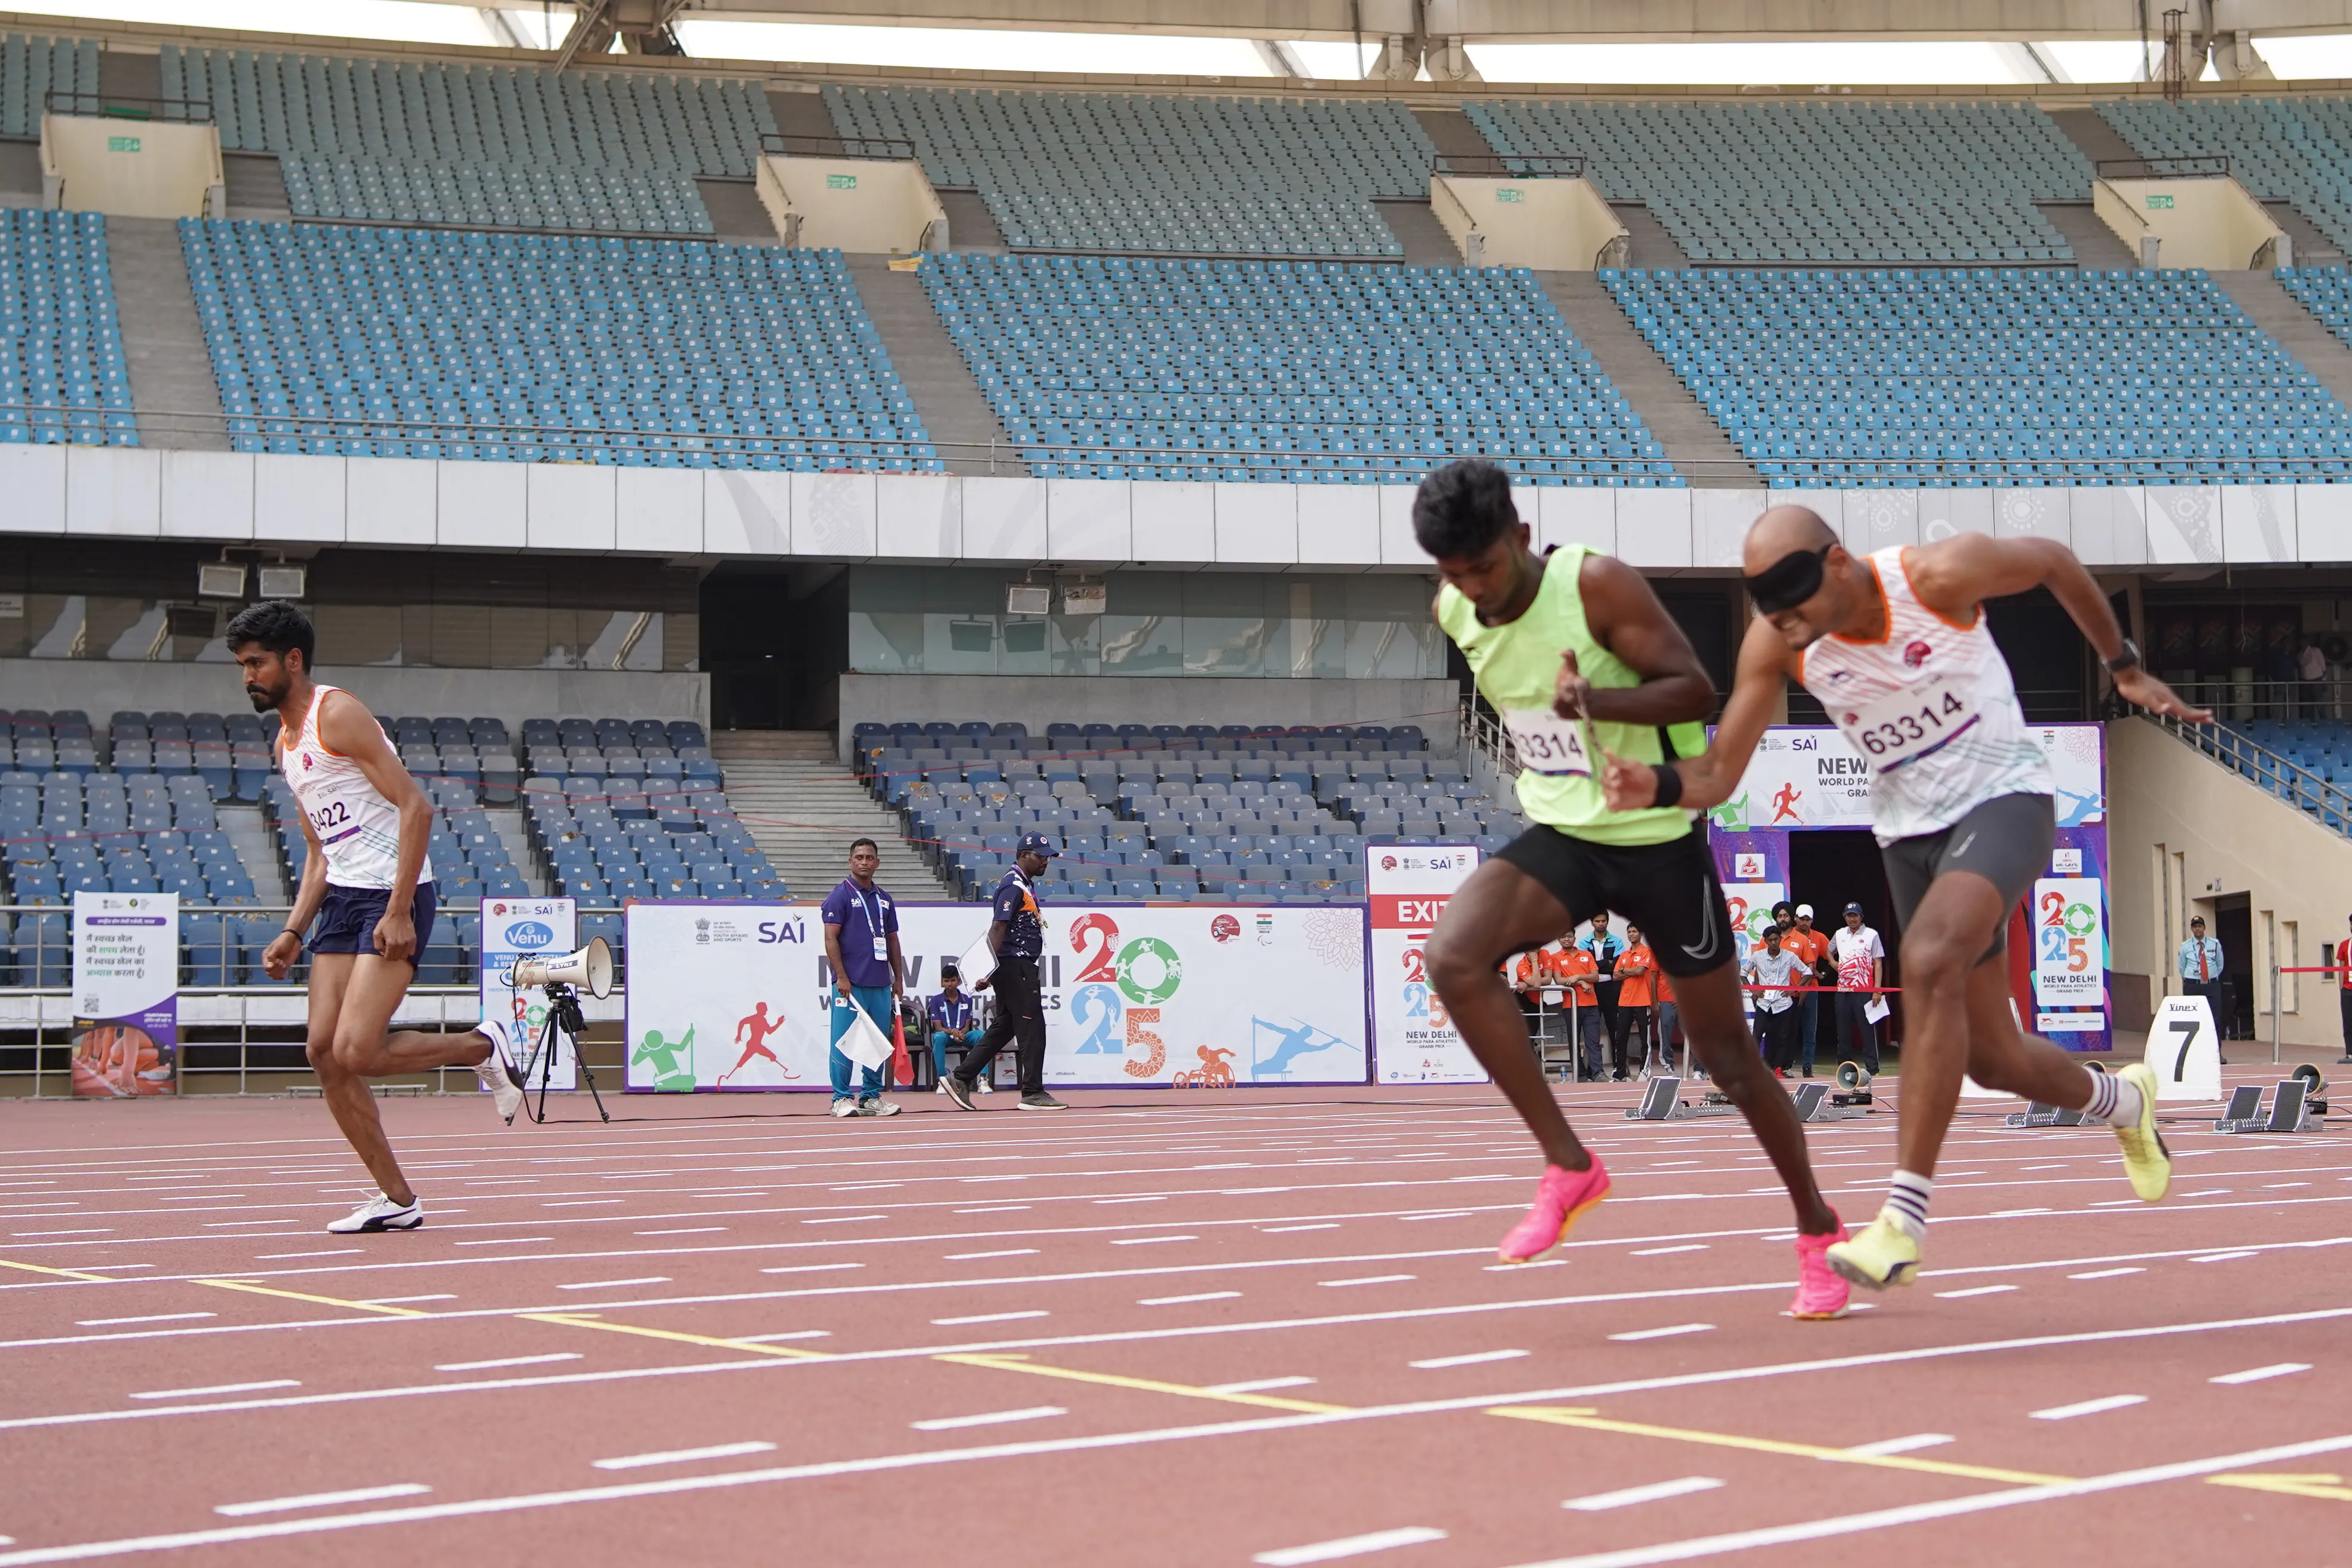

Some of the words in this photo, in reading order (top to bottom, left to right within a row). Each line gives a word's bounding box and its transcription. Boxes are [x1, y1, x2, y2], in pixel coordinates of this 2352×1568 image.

[1862, 691, 1962, 754] 63314
[1793, 739, 1817, 751] SAI
[1818, 758, 1868, 774] NEW
[1431, 859, 1451, 869] SAI
[535, 906, 552, 915] SAI
[507, 923, 547, 944] Venu
[758, 922, 804, 944] SAI
[2169, 1003, 2198, 1012] Vinex
[2169, 1021, 2200, 1082] 7
